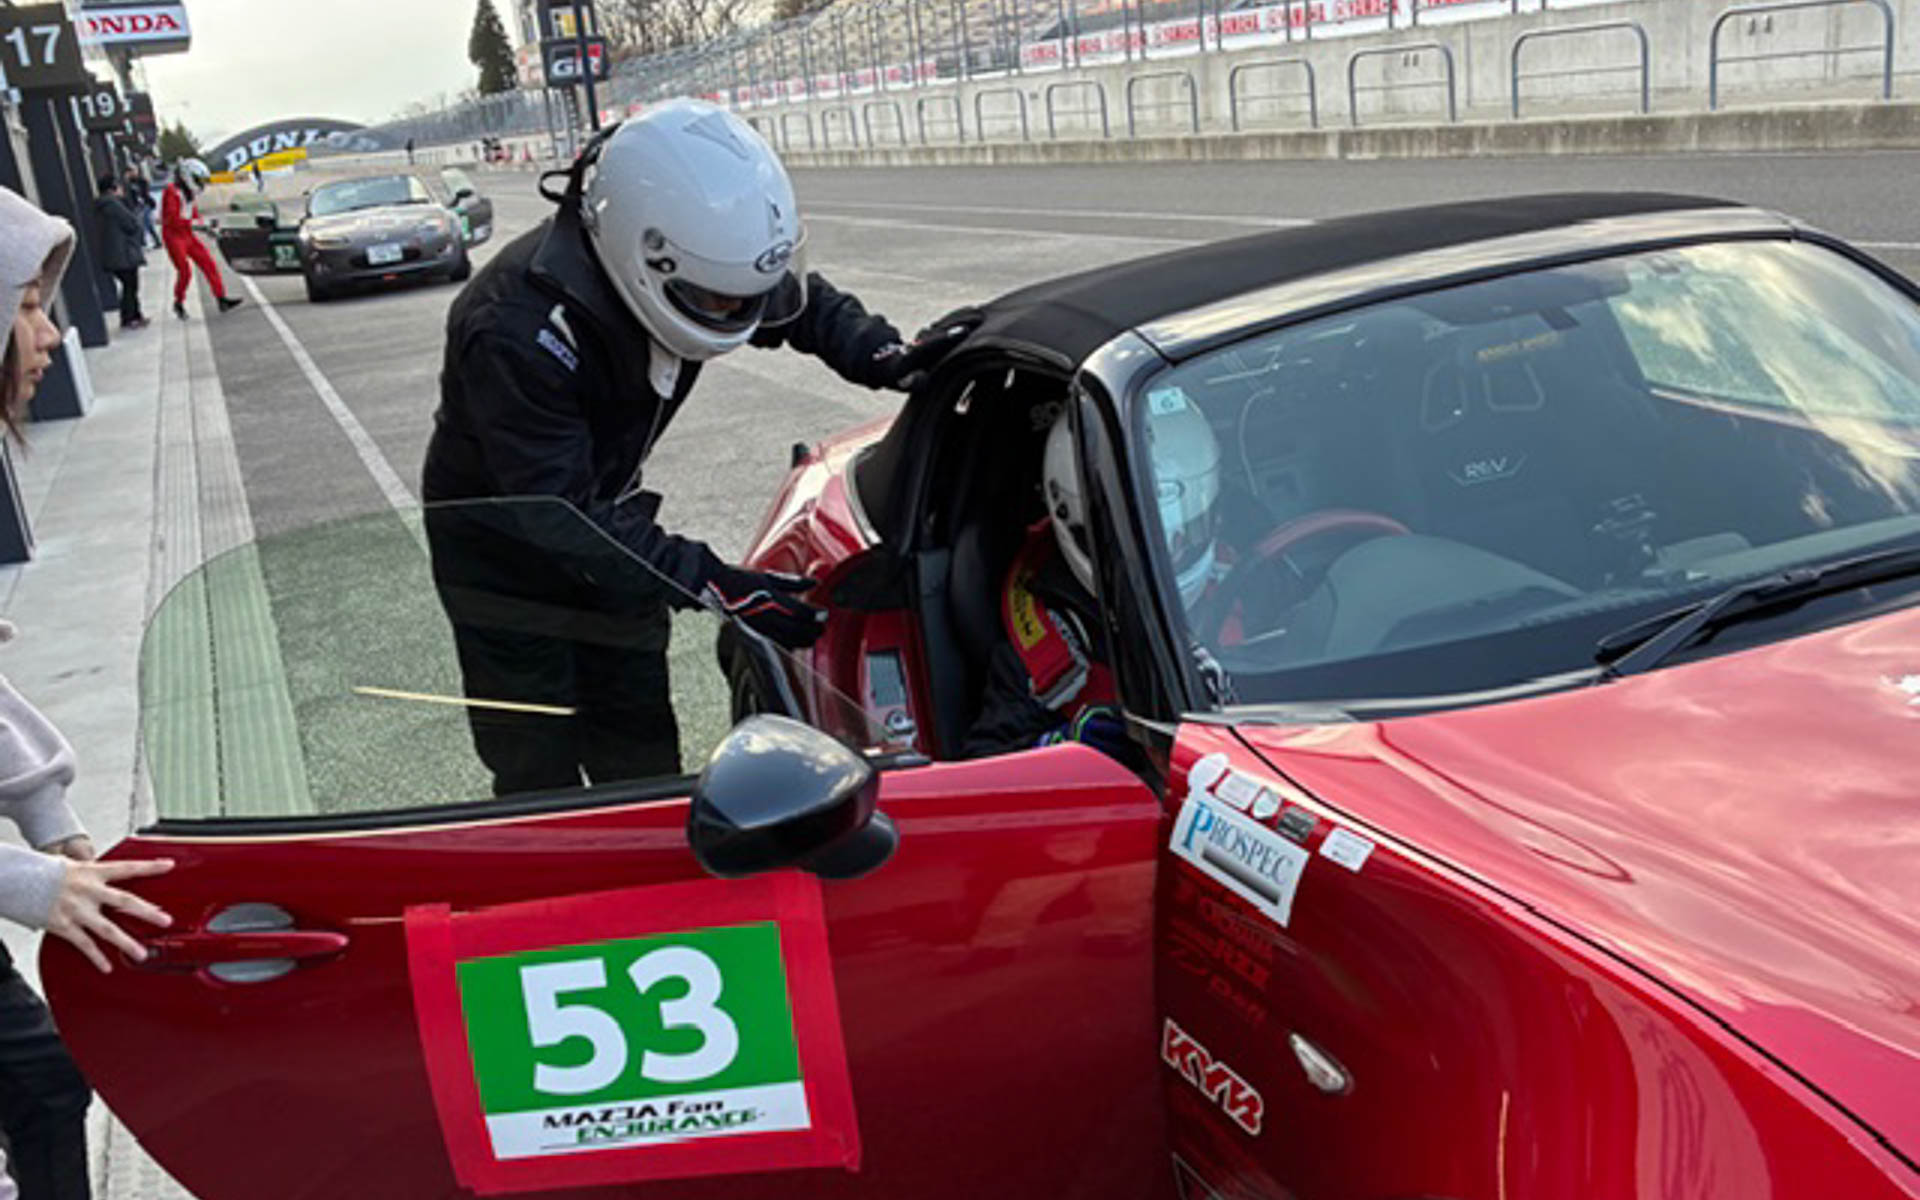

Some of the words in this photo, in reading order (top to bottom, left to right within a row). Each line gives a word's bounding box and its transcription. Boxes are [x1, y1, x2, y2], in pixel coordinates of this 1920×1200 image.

[5, 24, 61, 67] 17
[81, 92, 115, 118] 19
[1182, 801, 1294, 887] PROSPEC
[519, 945, 740, 1095] 53
[542, 1104, 658, 1129] MAZDA
[666, 1100, 724, 1116] Fan
